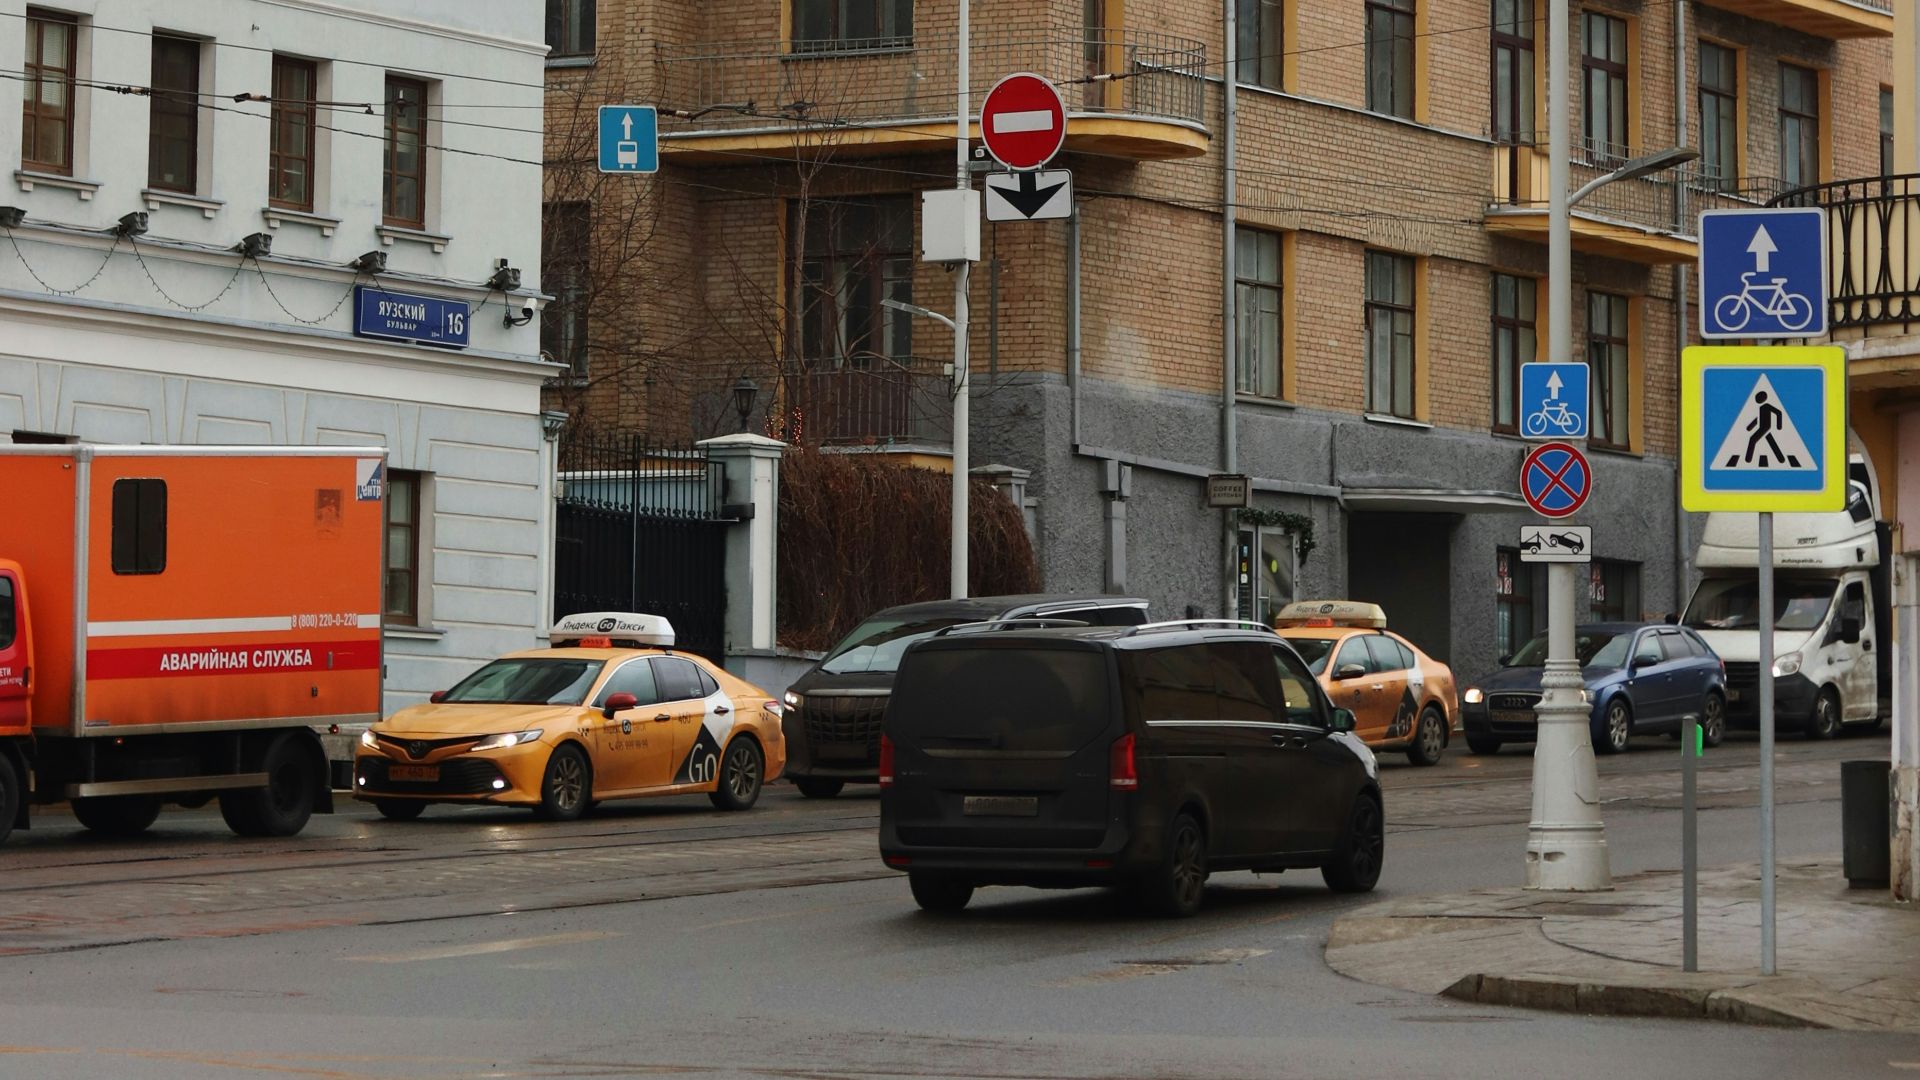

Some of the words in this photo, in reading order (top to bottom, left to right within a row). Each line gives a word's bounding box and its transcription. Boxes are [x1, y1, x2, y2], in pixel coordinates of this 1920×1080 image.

[379, 301, 425, 321] ЯУЗСКИЙ
[387, 320, 417, 331] БУЛЬВАР
[447, 312, 464, 335] 16
[292, 614, 298, 628] 8
[299, 614, 318, 629] (800)
[319, 613, 357, 627] 220-0-220
[563, 621, 597, 631] Яндекс
[616, 621, 645, 632] Такси
[160, 648, 248, 671] АВАРИЙНАЯ
[252, 649, 313, 667] СЛУЖБА
